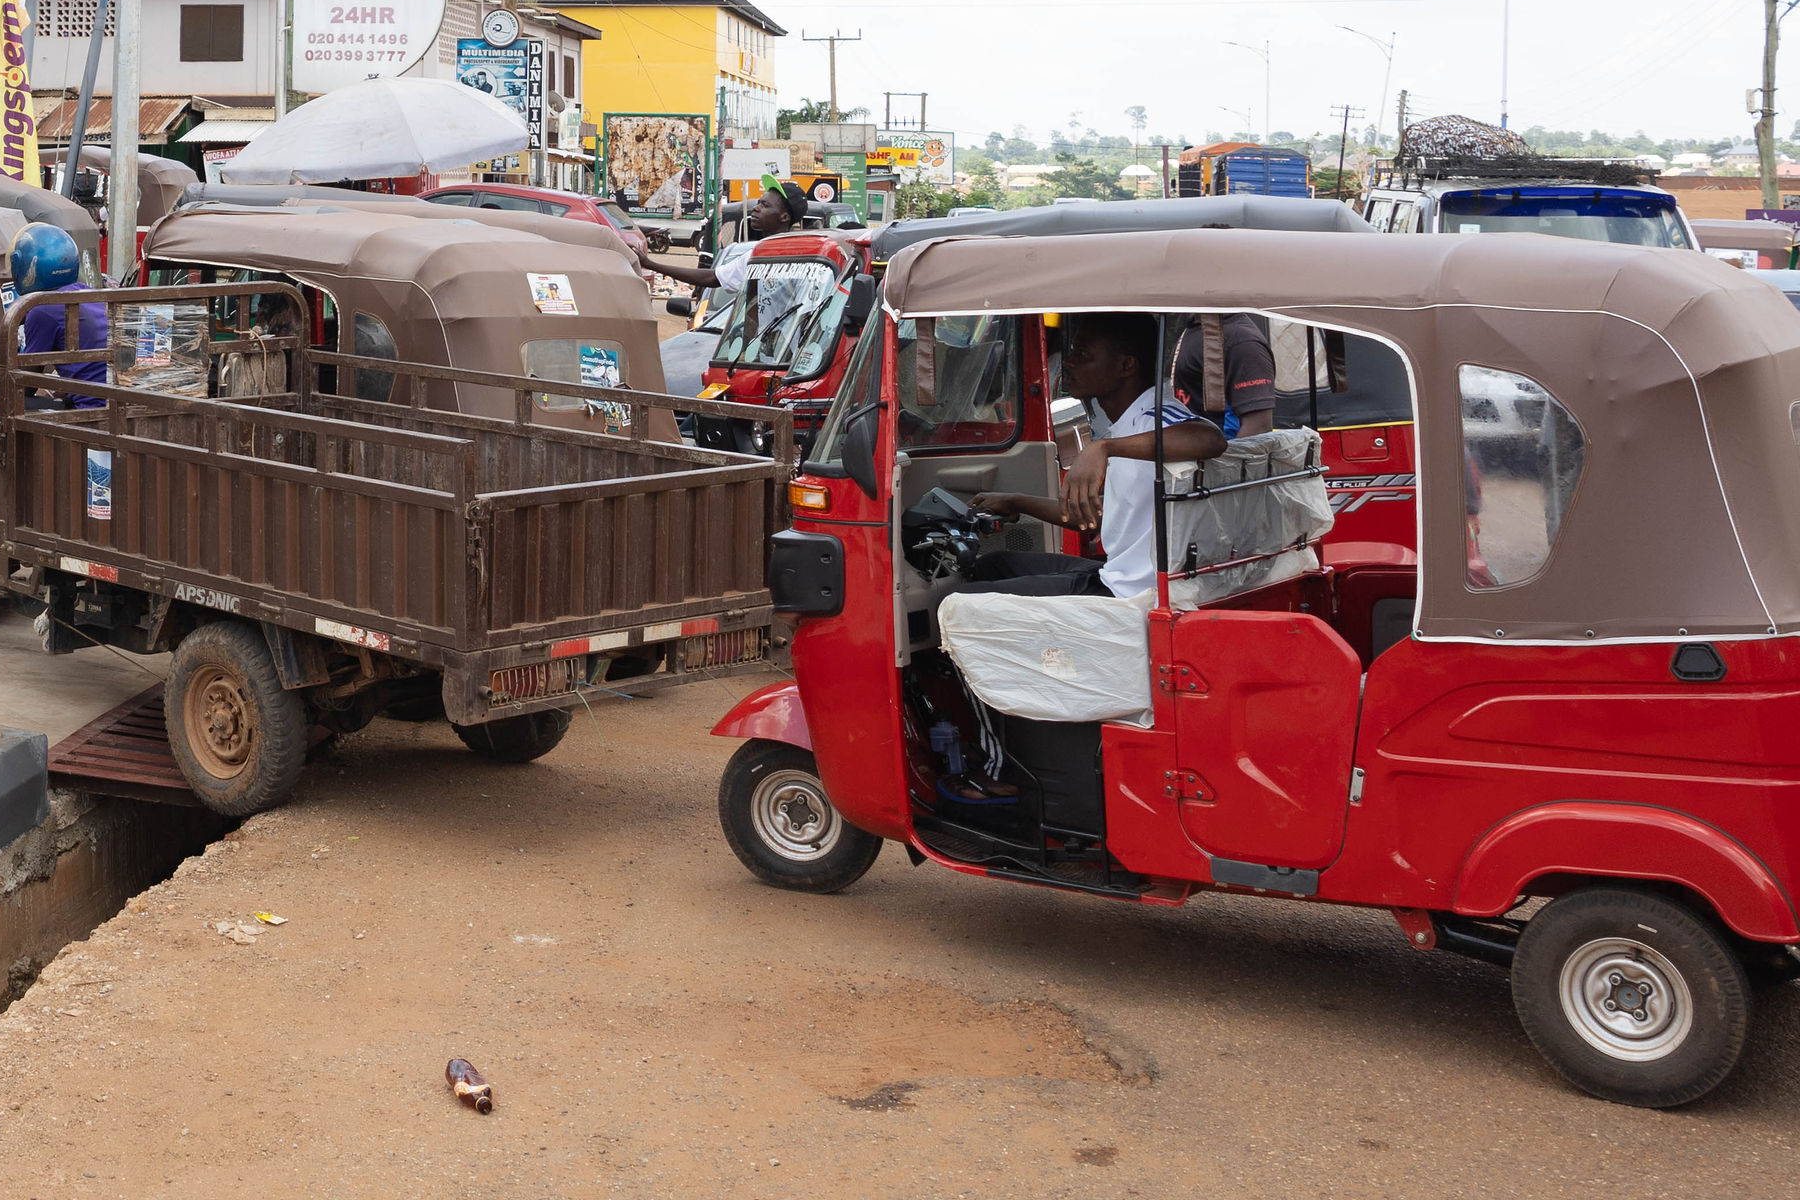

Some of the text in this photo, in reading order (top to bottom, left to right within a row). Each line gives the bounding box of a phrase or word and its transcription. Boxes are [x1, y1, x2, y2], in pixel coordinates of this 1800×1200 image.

[329, 6, 395, 25] 24HR
[308, 33, 408, 45] 020 414 1496
[305, 50, 406, 62] 020 399 3777
[461, 49, 525, 57] MULTIMEDIA
[529, 42, 542, 147] DANIMINA
[174, 583, 241, 614] APSONIC
